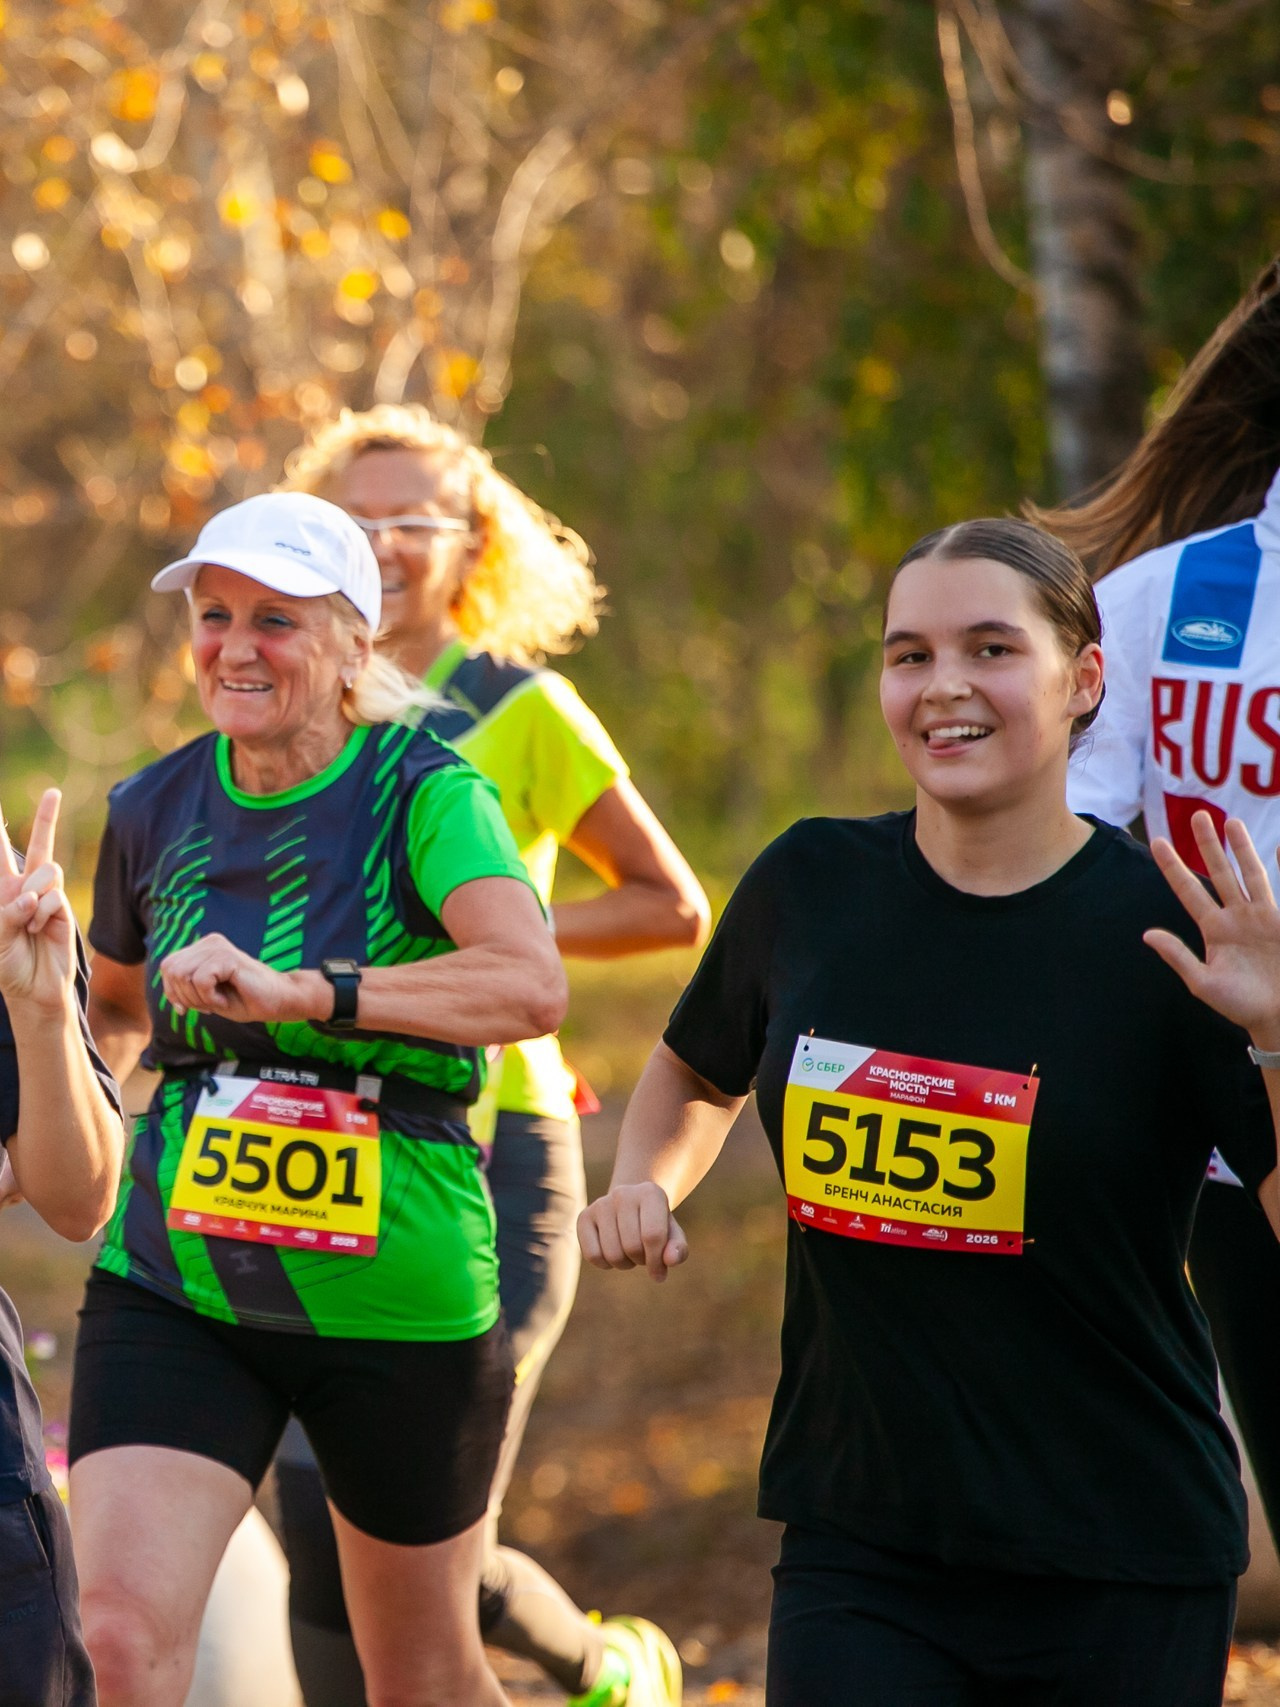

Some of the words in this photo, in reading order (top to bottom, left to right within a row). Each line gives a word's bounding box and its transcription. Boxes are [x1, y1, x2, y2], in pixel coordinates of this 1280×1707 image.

[816, 1061, 845, 1073] СБЕР
[869, 1065, 955, 1090] КРАСНОЯРСКИЕ
[889, 1081, 930, 1096] МОСТЫ
[890, 1092, 926, 1104] МАРАФОН
[983, 1092, 992, 1104] 5
[802, 1101, 996, 1202] 5153
[192, 1127, 364, 1208] 5501
[213, 1195, 268, 1213] КРАВЧУК
[270, 1203, 329, 1221] МАРИНА
[824, 1183, 869, 1203] БРЕНЧ
[871, 1192, 963, 1218] АНАСТАСИЯ
[966, 1234, 999, 1245] 2026
